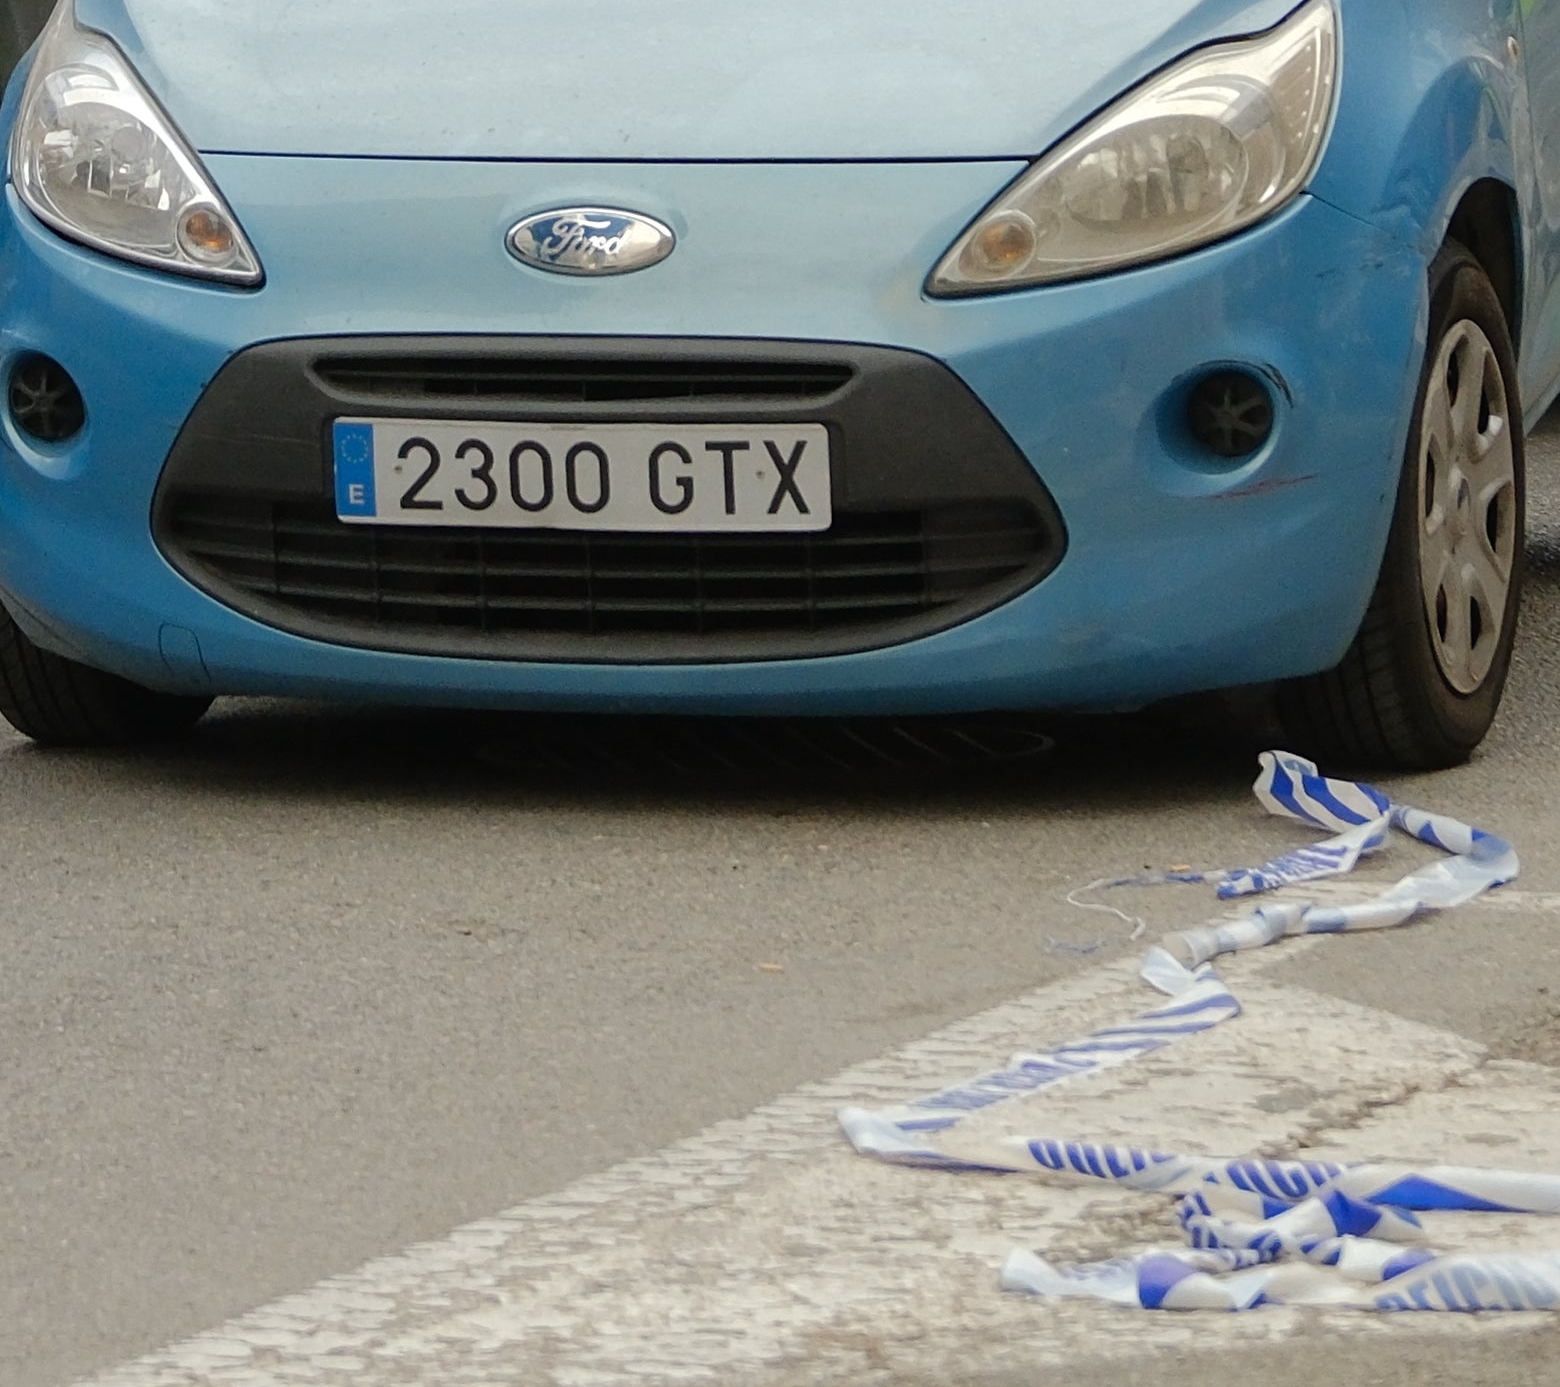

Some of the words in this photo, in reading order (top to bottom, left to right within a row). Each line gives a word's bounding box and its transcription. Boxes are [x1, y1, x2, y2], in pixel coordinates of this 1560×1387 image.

[539, 214, 633, 263] Ford
[348, 482, 365, 507] E
[395, 435, 610, 517] 2300
[647, 437, 812, 518] GTX
